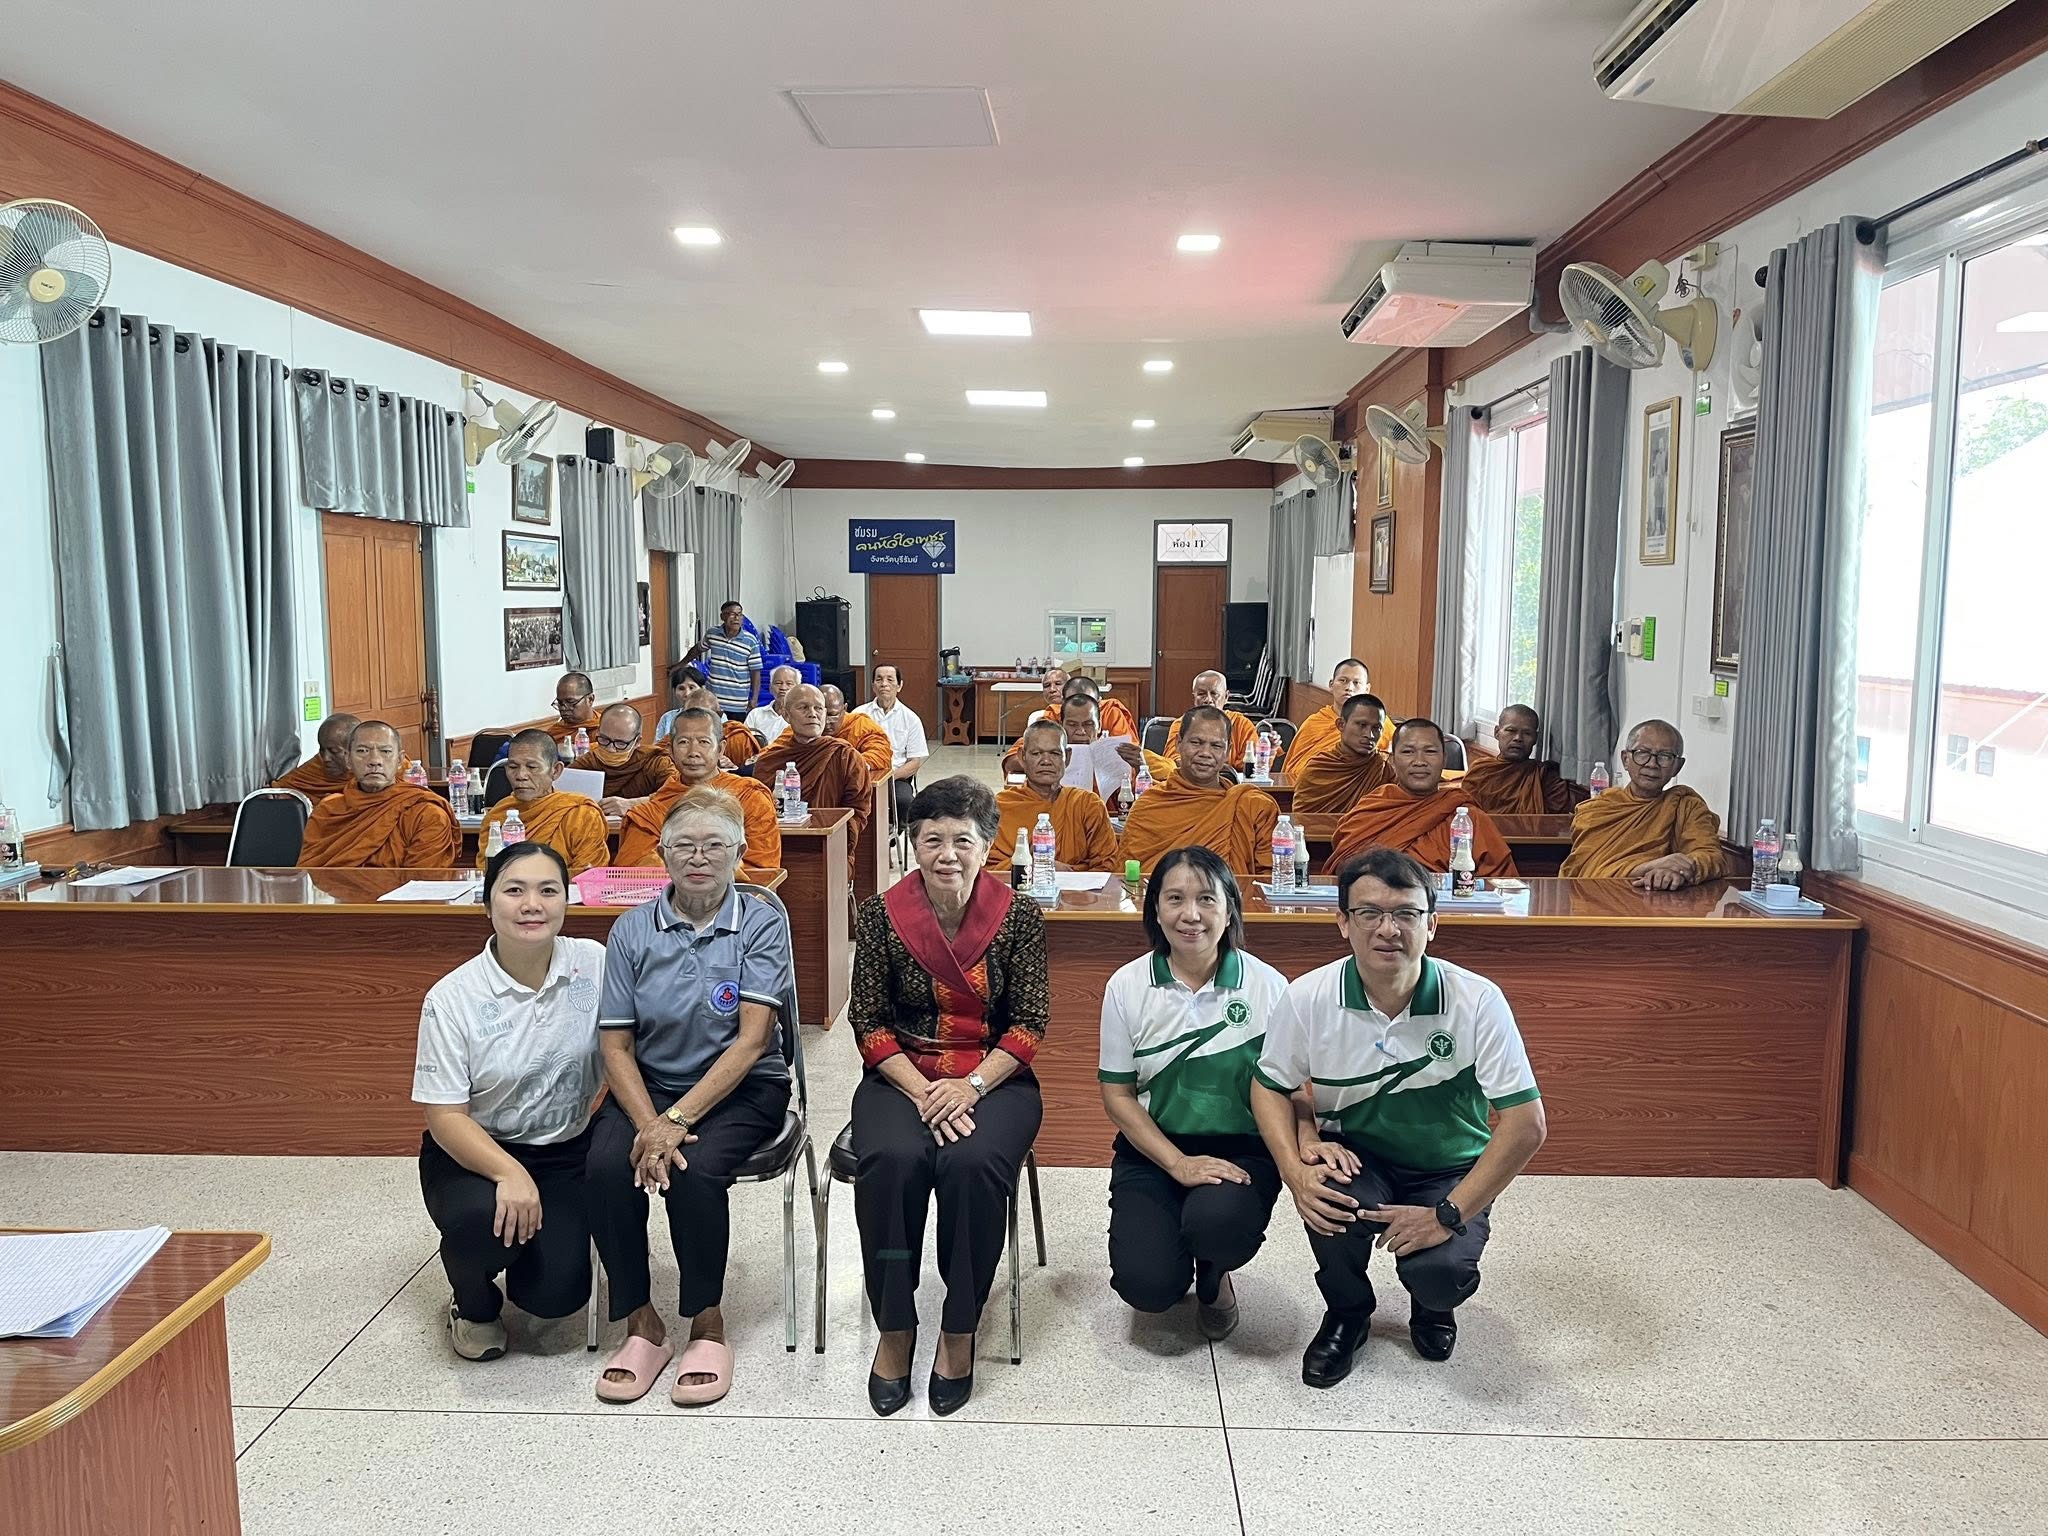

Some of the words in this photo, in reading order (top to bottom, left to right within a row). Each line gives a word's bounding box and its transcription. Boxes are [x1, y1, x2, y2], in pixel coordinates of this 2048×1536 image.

[854, 526, 878, 538] ชมรม
[1172, 538, 1190, 548] ห้อง
[1195, 540, 1206, 548] IT
[476, 1020, 514, 1038] YAMAHA
